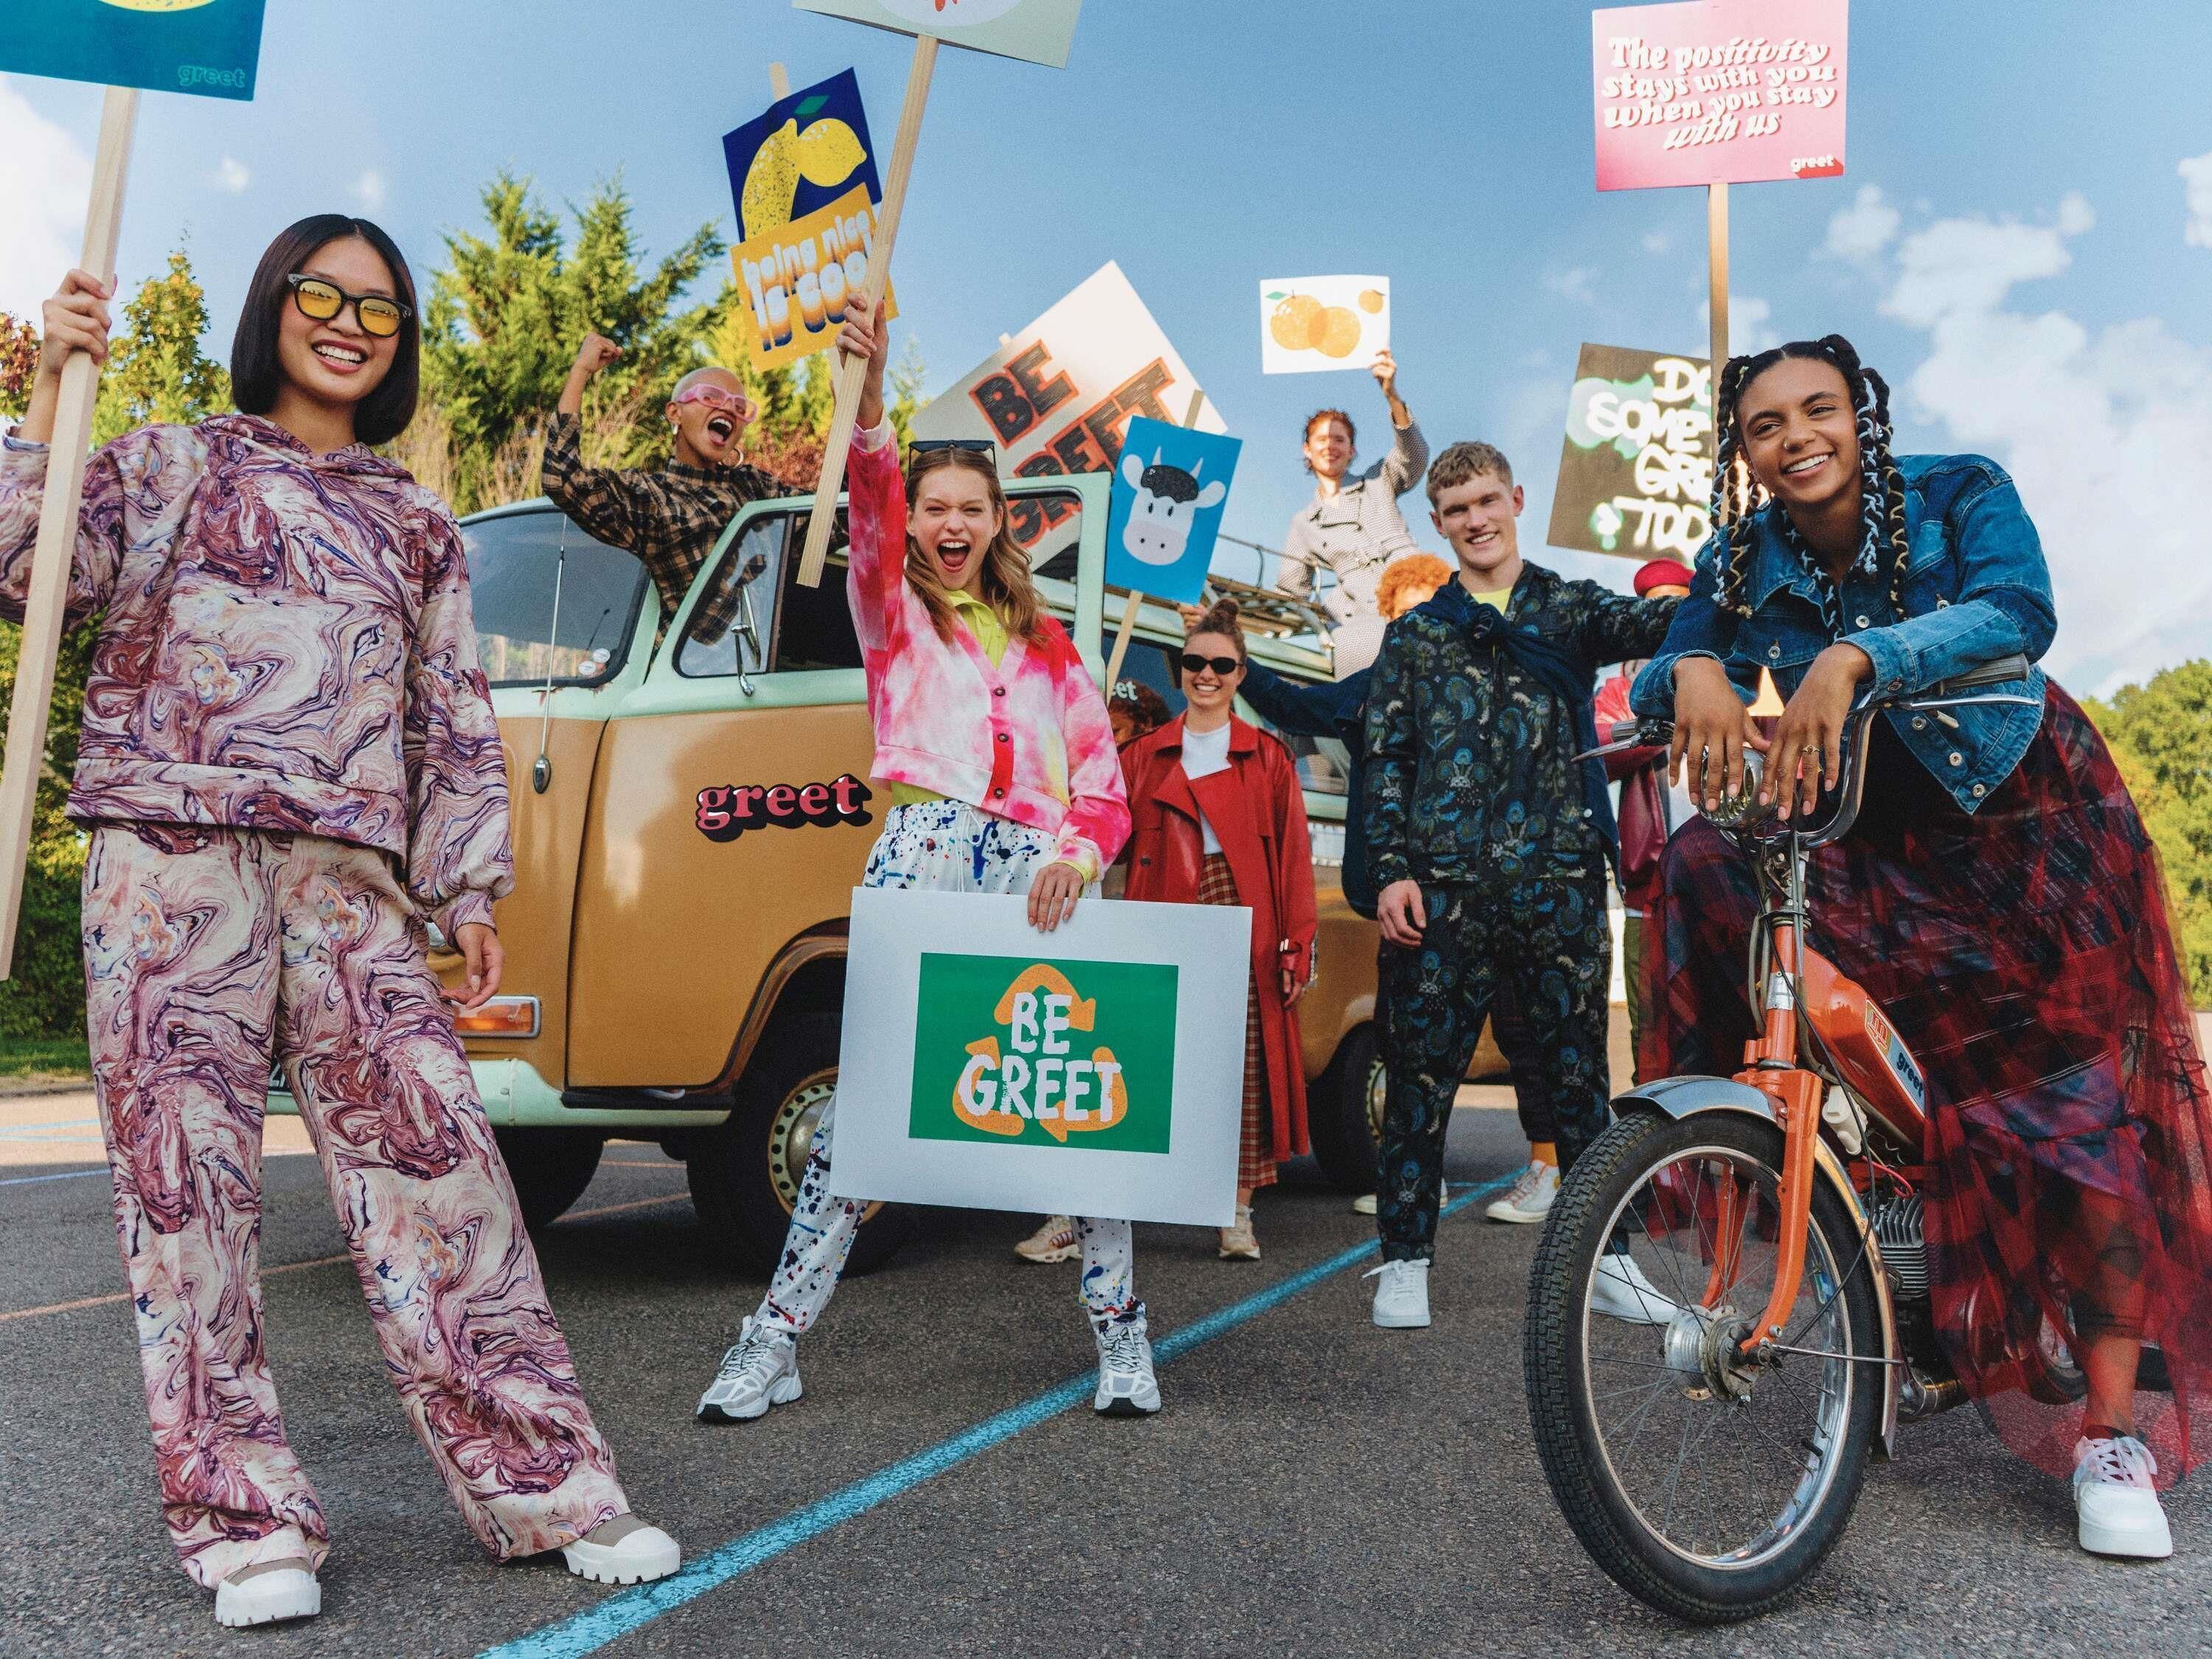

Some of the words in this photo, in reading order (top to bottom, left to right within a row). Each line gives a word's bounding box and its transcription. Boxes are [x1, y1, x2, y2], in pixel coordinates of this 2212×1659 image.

[1608, 37, 1668, 69] The
[1674, 38, 1830, 74] positivity
[178, 65, 246, 88] greet
[1601, 73, 1689, 102] stays
[1694, 65, 1760, 93] with
[1765, 65, 1837, 87] you
[1708, 89, 1761, 116] you
[1767, 85, 1837, 108] stay
[1663, 113, 1740, 150] with
[1745, 112, 1782, 138] us
[1790, 154, 1835, 173] greet
[968, 339, 1079, 450] BE
[696, 774, 863, 833] greet
[1011, 992, 1072, 1054] BE
[958, 1054, 1122, 1122] GREET
[1896, 1052, 1924, 1098] greet
